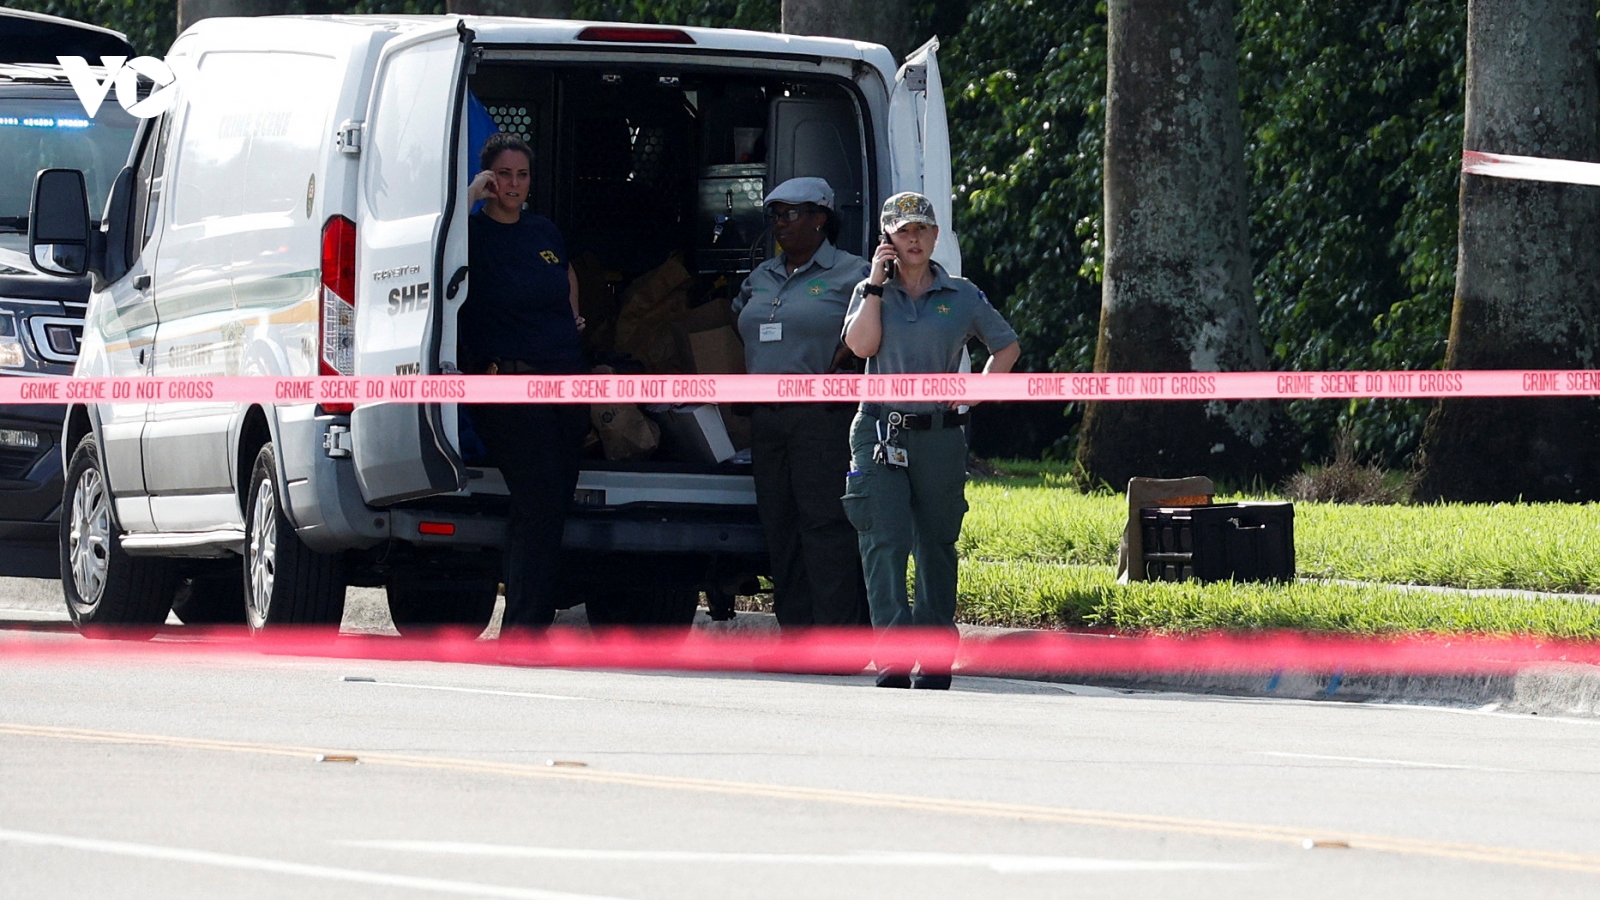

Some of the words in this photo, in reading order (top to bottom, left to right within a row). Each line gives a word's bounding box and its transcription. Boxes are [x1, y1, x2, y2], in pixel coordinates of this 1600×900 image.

[387, 282, 430, 317] SHE
[19, 381, 59, 399] CRIME
[65, 381, 105, 399] SCENE
[111, 381, 131, 399] DO
[135, 381, 163, 399] NOT
[168, 381, 214, 399] CROSS
[274, 380, 314, 398] CRIME
[319, 380, 359, 398] SCENE
[365, 380, 385, 398] DO
[389, 380, 417, 398] NOT
[420, 380, 466, 398] CROSS
[526, 379, 566, 398] CRIME
[571, 379, 611, 398] SCENE
[616, 379, 635, 398] DO
[639, 379, 668, 398] NOT
[671, 379, 717, 398] CROSS
[777, 379, 817, 398] CRIME
[822, 378, 862, 397] SCENE
[867, 378, 886, 397] DO
[890, 378, 918, 397] NOT
[921, 378, 967, 397] CROSS
[1027, 377, 1066, 395] CRIME
[1071, 377, 1111, 395] SCENE
[1116, 377, 1136, 395] DO
[1139, 375, 1168, 395] NOT
[1170, 375, 1217, 395] CROSS
[1276, 374, 1316, 393] CRIME
[1320, 374, 1361, 393] SCENE
[1364, 374, 1384, 393] DO
[1387, 373, 1414, 392] NOT
[1418, 373, 1463, 392] CROSS
[1522, 372, 1561, 391] CRIME
